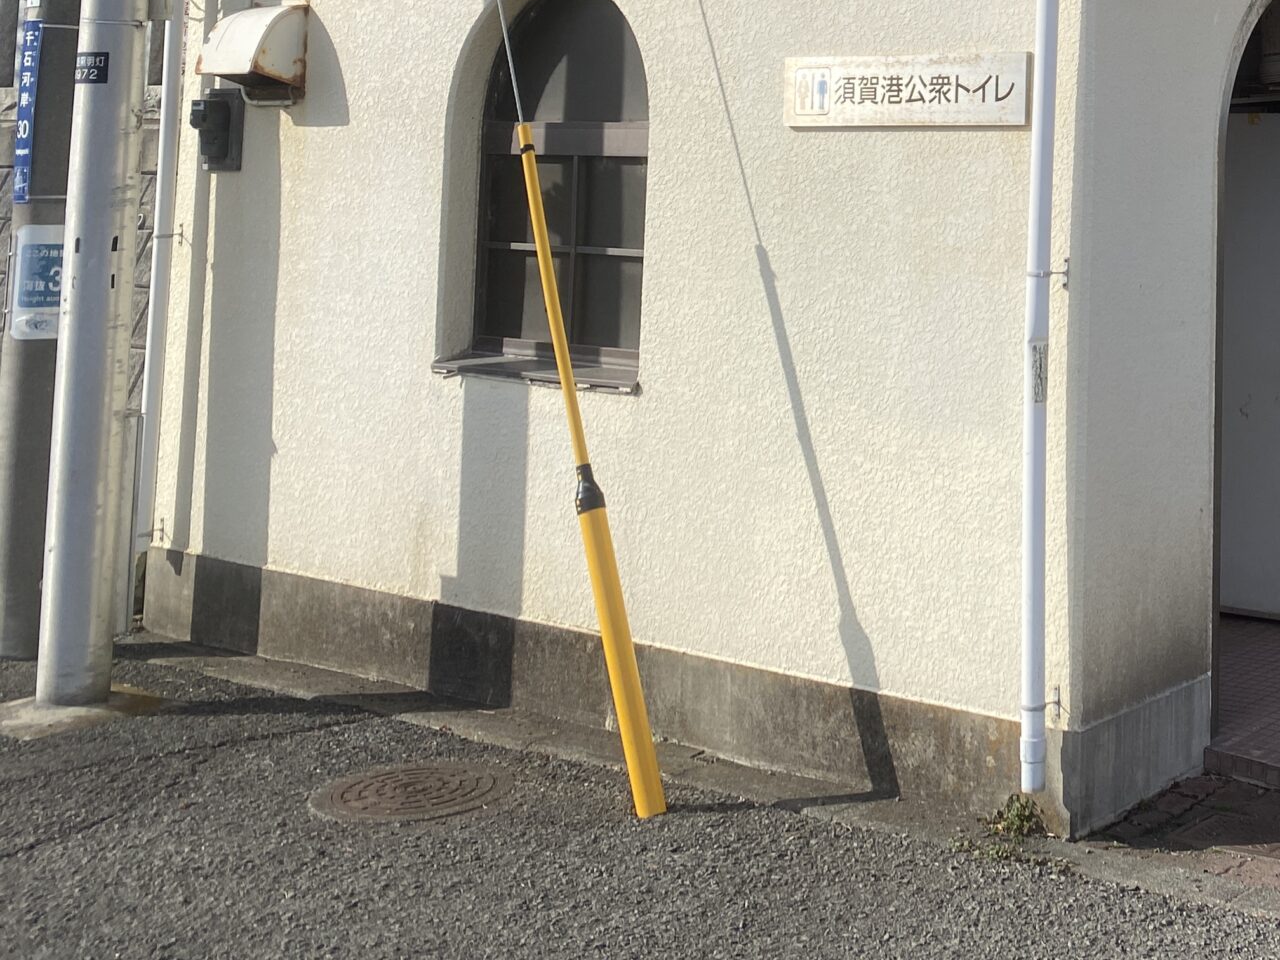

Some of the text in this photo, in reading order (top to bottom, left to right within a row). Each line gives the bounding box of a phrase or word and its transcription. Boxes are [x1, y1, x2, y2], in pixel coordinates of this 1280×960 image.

[20, 30, 34, 108] 千石河岸
[834, 73, 1015, 105] 須賀港公衆トイレ
[17, 120, 29, 138] 30
